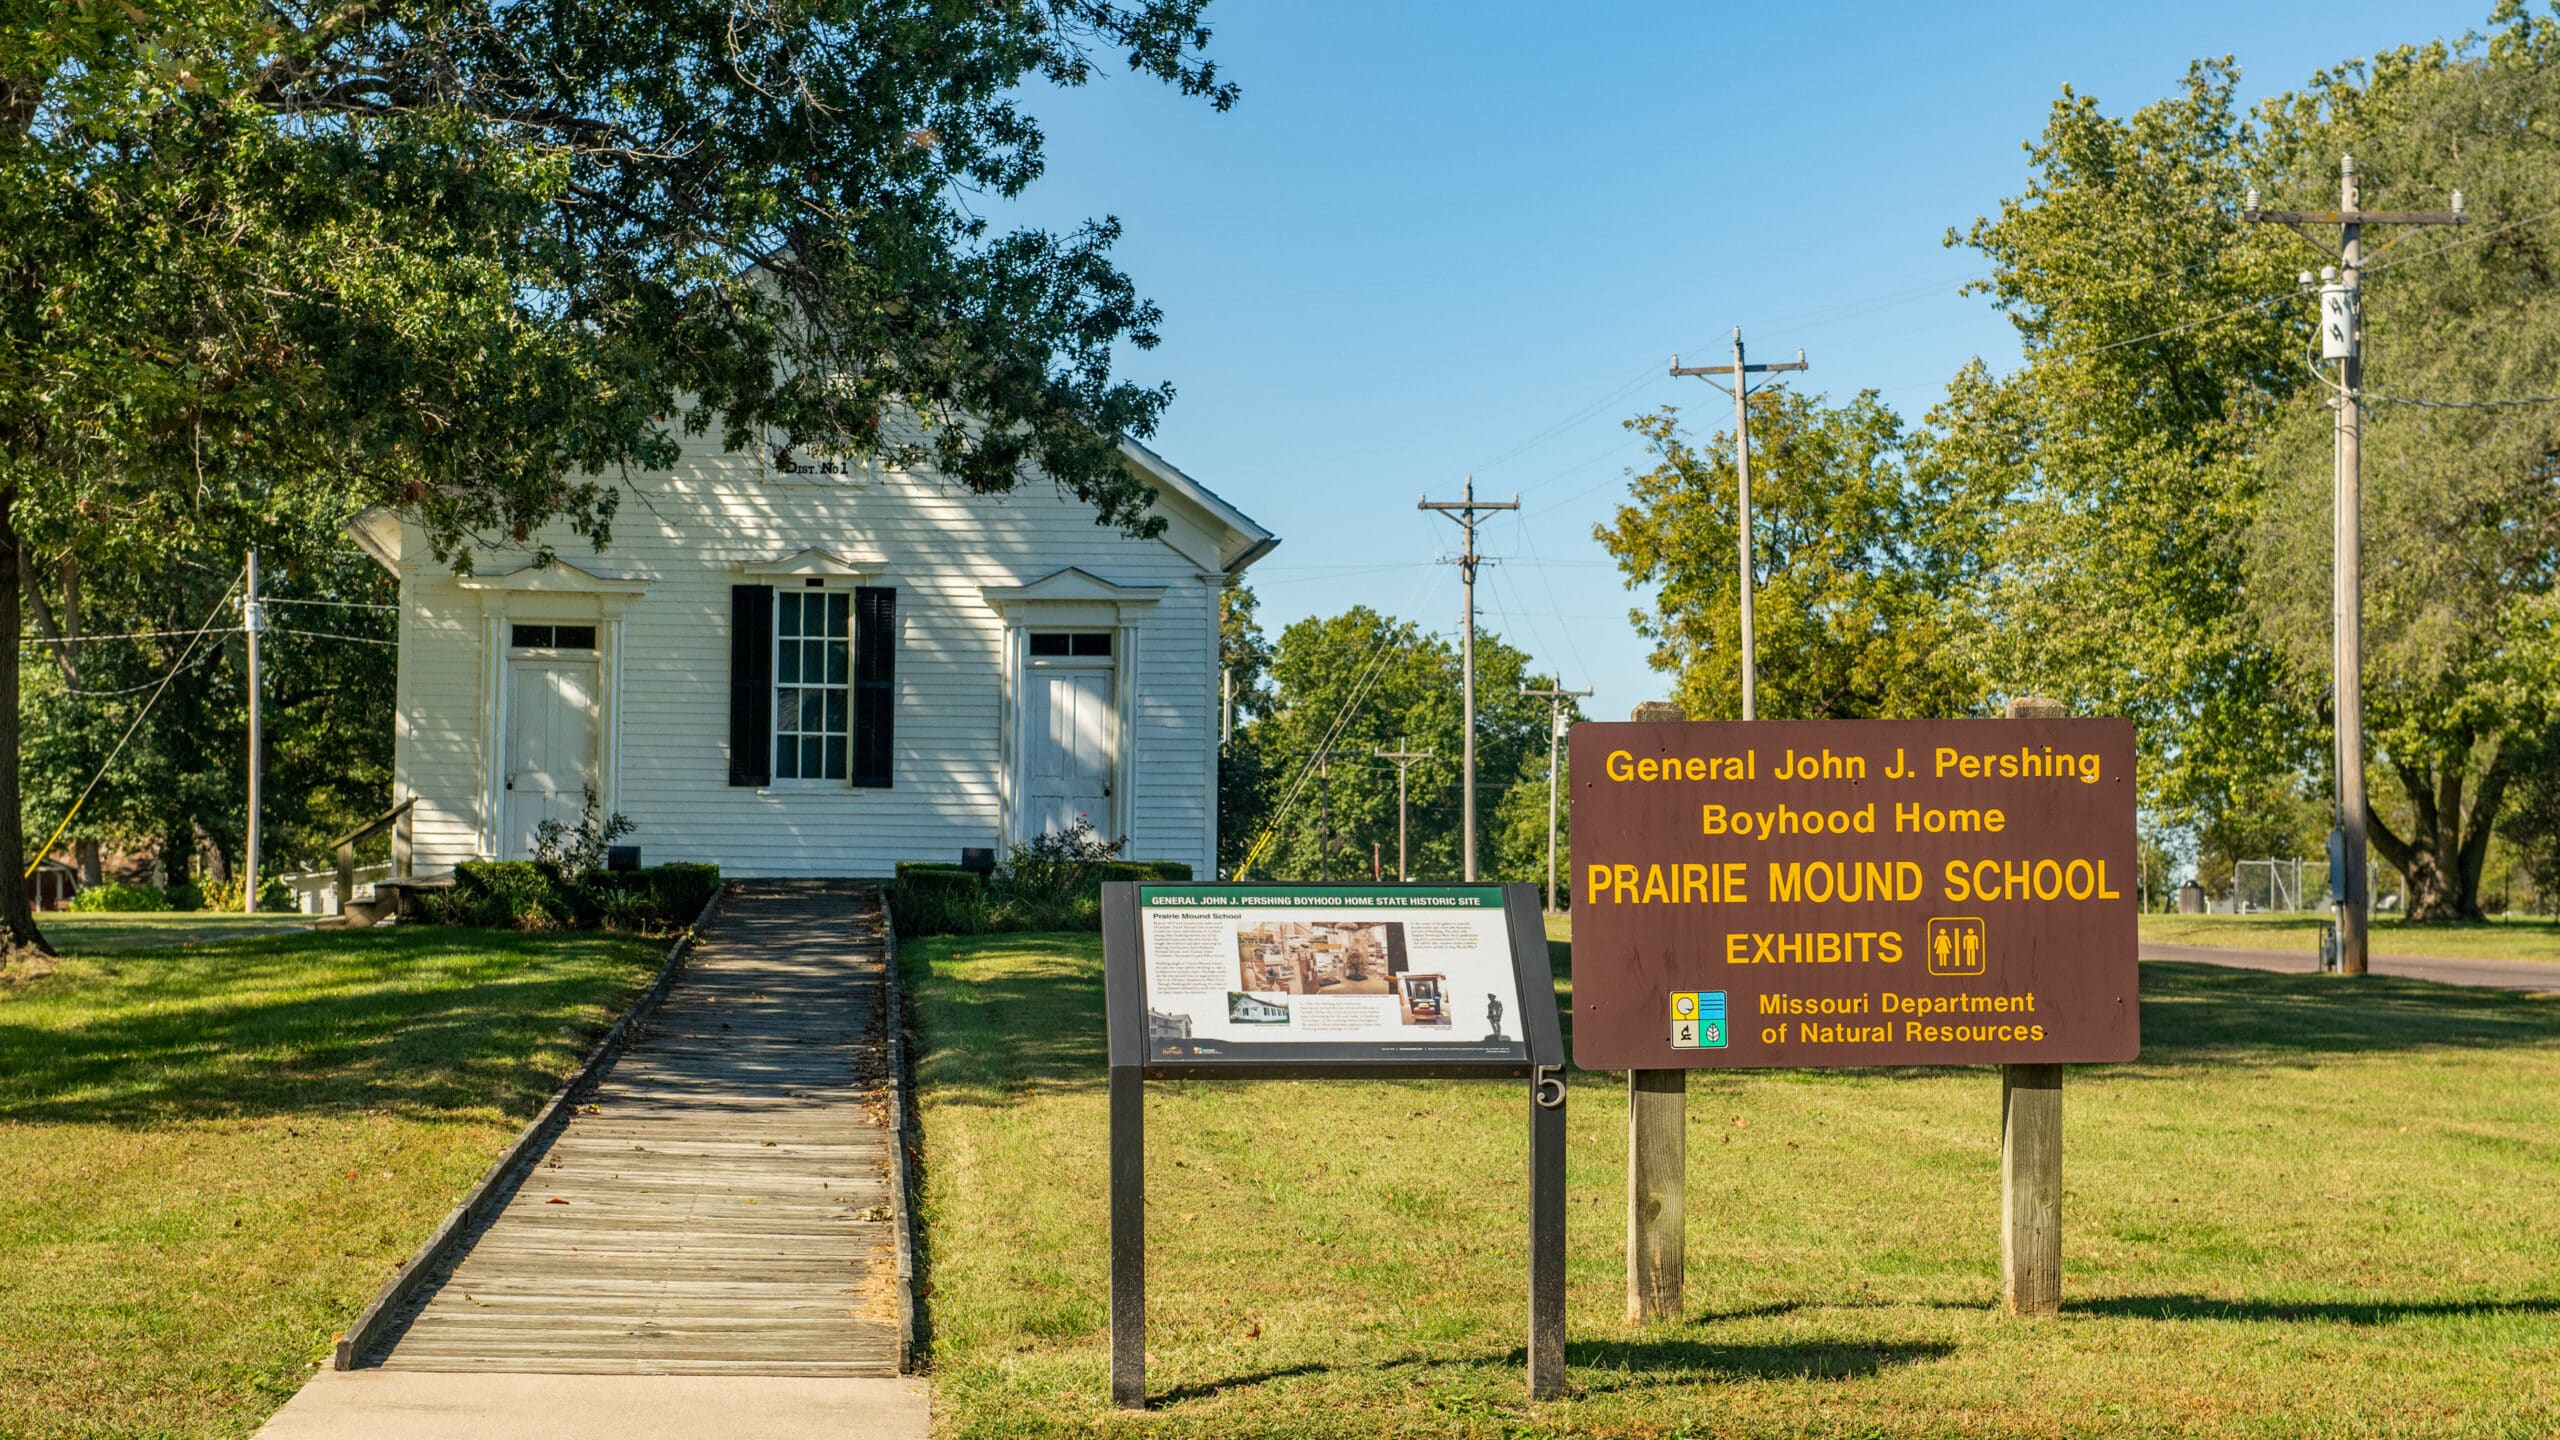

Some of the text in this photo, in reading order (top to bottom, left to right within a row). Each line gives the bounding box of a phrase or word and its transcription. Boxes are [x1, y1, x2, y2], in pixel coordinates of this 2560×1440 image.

[1606, 747, 2101, 784] General John J. Pershing
[1703, 802, 2006, 840] Boyhood Home
[1588, 859, 2120, 904] PRAIRIE MOUND SCHOOL
[1151, 896, 1481, 906] GENERAL JOHN J. PERSHING BOYHOOD HOME STATE HISTORIC SITE
[1152, 912, 1242, 920] Prairie Mound School
[1727, 931, 1903, 964] EXHIBITS
[1760, 992, 2035, 1017] Missouri Department
[1761, 1022, 2043, 1044] of Natural Resources
[1537, 1064, 1566, 1107] 5
